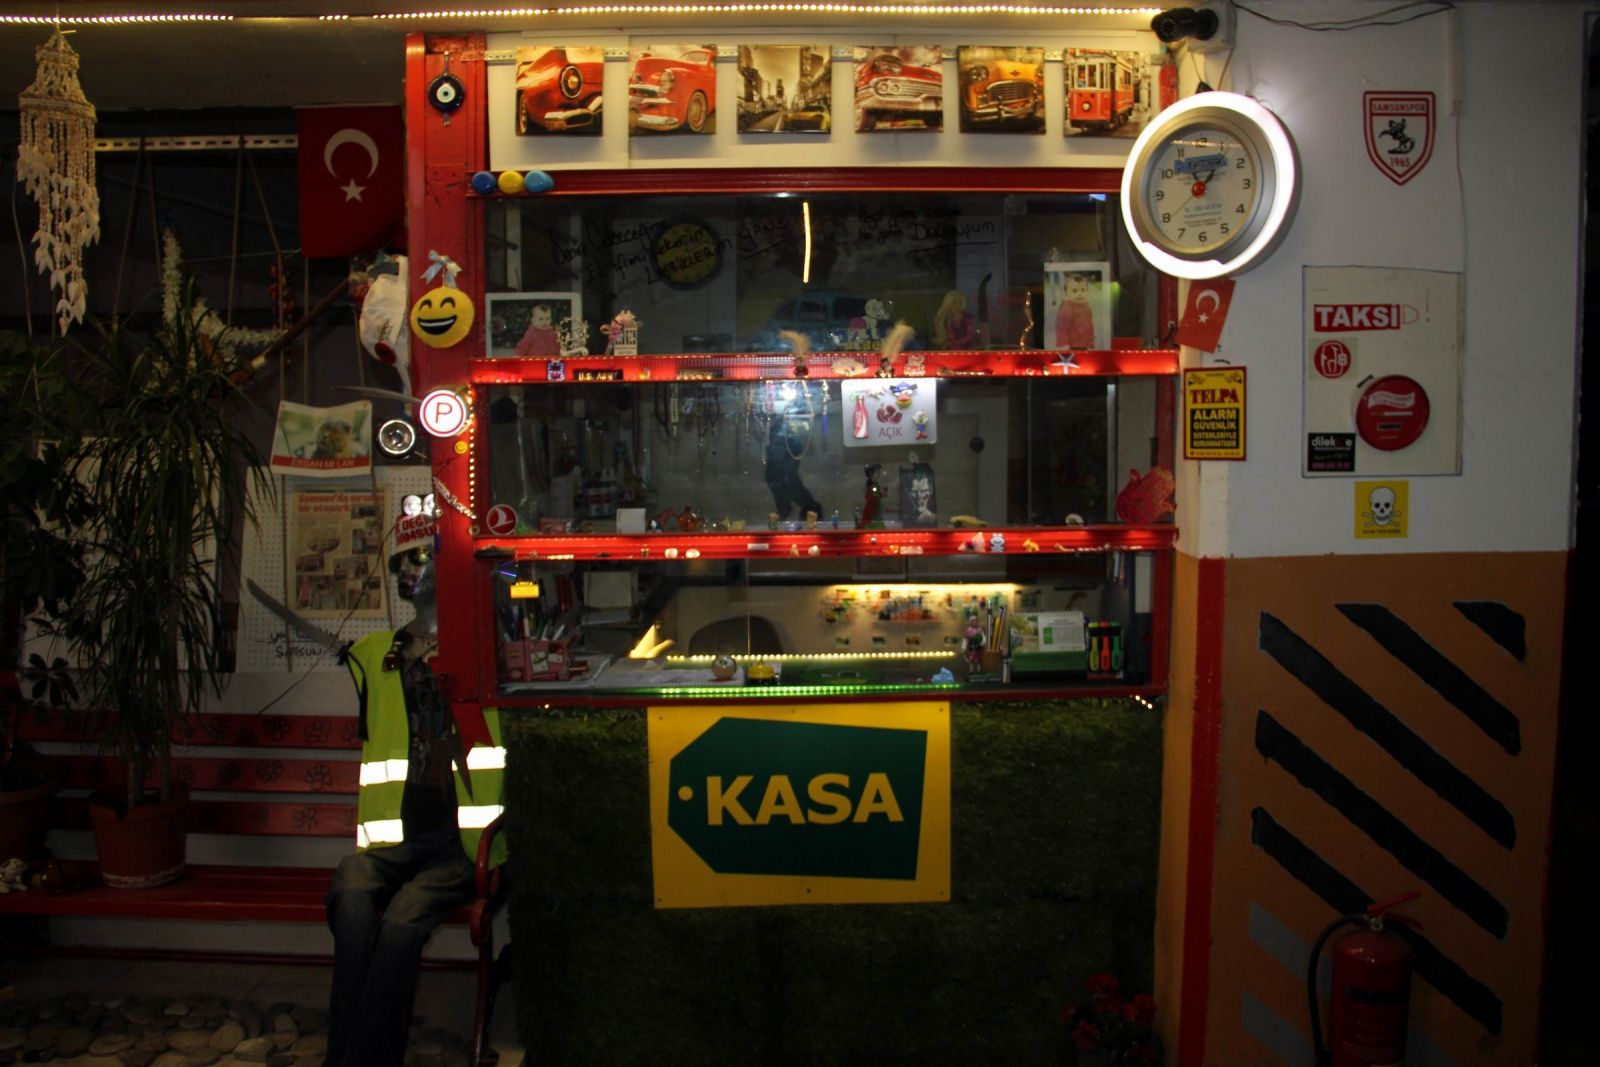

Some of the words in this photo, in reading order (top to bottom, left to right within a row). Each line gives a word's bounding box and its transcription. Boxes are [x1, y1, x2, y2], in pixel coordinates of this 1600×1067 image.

[1372, 103, 1425, 112] SAMSUNSPOR
[1177, 148, 1185, 158] 11
[1236, 158, 1246, 169] 2
[1390, 157, 1410, 167] 1965
[1161, 168, 1174, 180] 10
[1242, 179, 1251, 189] 3
[1156, 190, 1165, 201] 9
[1235, 204, 1246, 214] 4
[1162, 213, 1171, 223] 8
[1177, 228, 1186, 239] 7
[1219, 223, 1230, 234] 5
[1198, 231, 1208, 242] 6
[1190, 388, 1239, 404] TELPA
[435, 402, 453, 424] P
[1193, 409, 1236, 420] ALARM
[1193, 420, 1236, 430] GÜVENLİK
[878, 427, 903, 439] AÇIK
[706, 772, 905, 826] KASA
